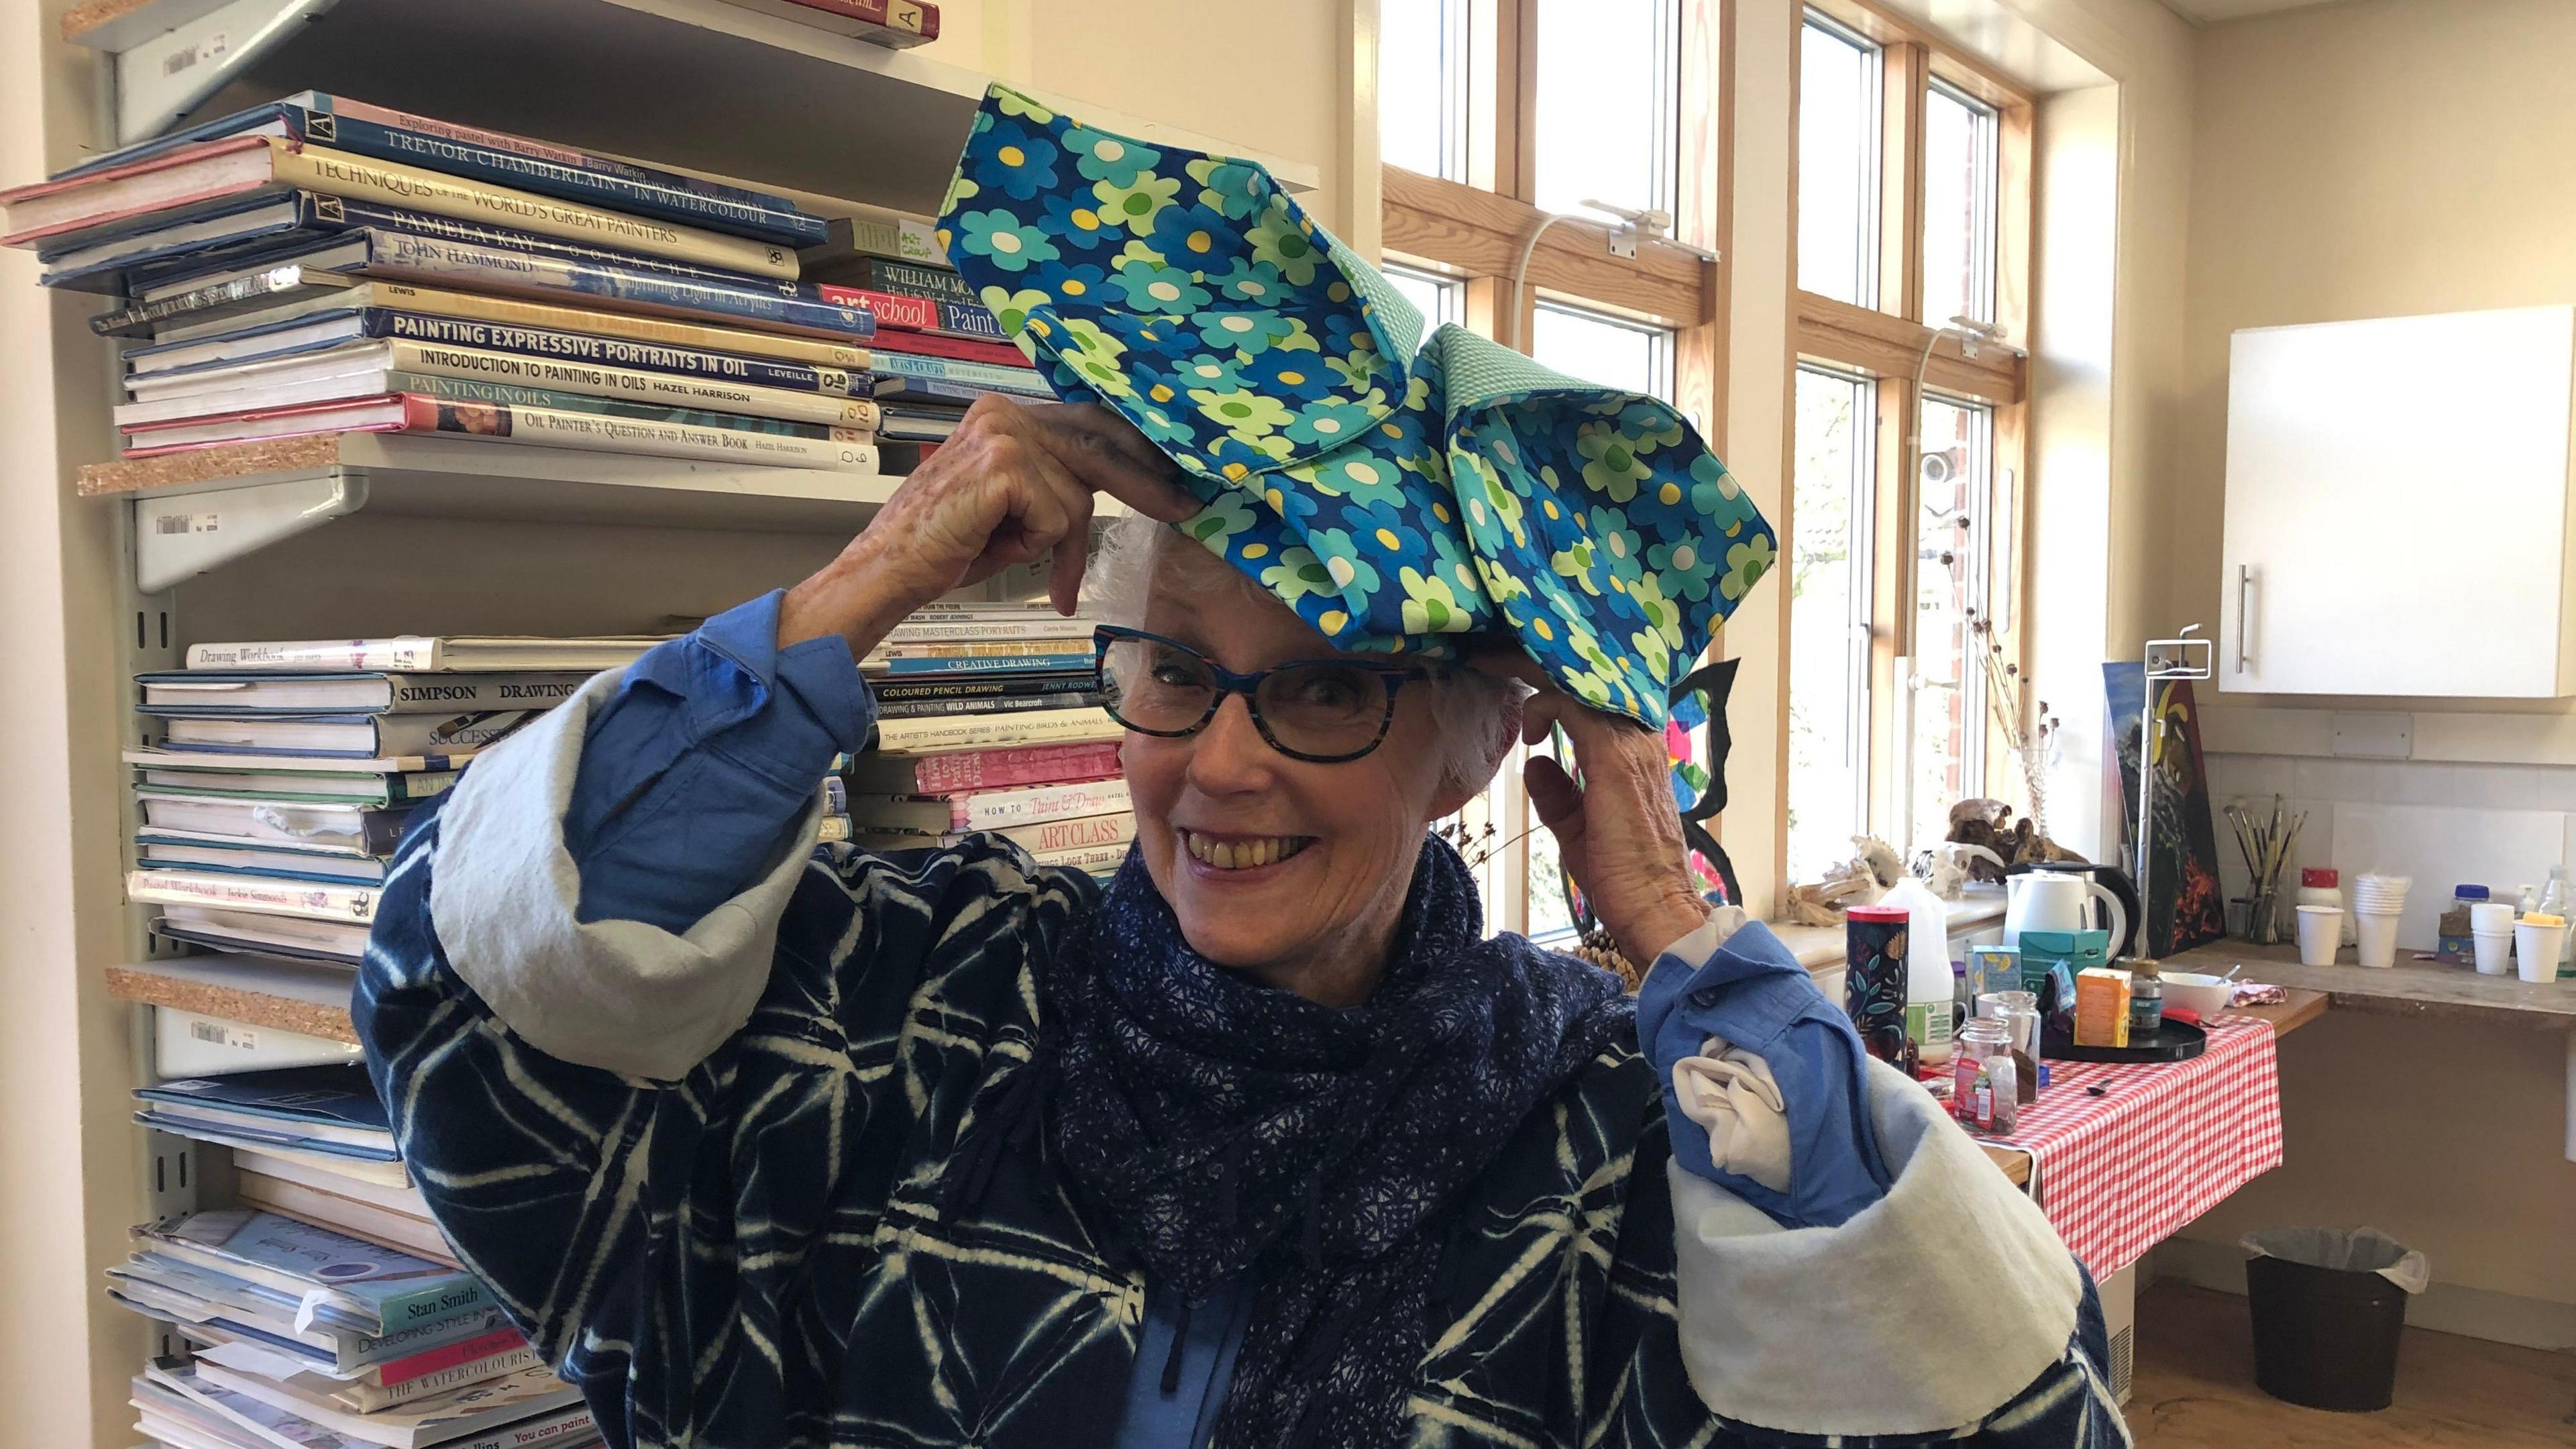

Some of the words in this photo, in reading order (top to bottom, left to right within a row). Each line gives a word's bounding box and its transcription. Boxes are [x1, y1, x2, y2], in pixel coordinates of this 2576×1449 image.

[898, 11, 917, 27] A
[311, 117, 333, 135] A
[399, 114, 451, 139] Exploring
[455, 129, 484, 146] pastel
[486, 136, 511, 150] with
[514, 142, 539, 158] Barry
[543, 148, 577, 164] Watkin
[385, 130, 470, 162] TREVOR
[477, 150, 616, 191] CHAMBERLAIN
[587, 158, 611, 174] Barry
[614, 164, 645, 179] Watkin
[315, 158, 433, 197] TECHNIQUES
[436, 186, 450, 196] OF
[452, 189, 470, 201] THE
[473, 191, 548, 220] WORLD'S
[552, 207, 602, 229] GREAT
[608, 218, 678, 244] PAINTERS
[320, 200, 341, 217] A
[634, 186, 650, 201] IN
[657, 191, 767, 225] WATERCOLOUR
[392, 210, 488, 244] PAMELA
[495, 229, 535, 252] KAY
[569, 244, 699, 278] GOUACHE
[396, 237, 441, 260] JOHN
[447, 244, 534, 274] HAMMOND
[388, 286, 416, 297] LEWIS
[884, 266, 947, 291] WILLIAM
[950, 278, 976, 296] MO
[683, 284, 710, 305] Light
[714, 289, 726, 303] in
[729, 292, 773, 313] Acrylics
[832, 294, 871, 309] art
[874, 296, 927, 325] school
[947, 305, 996, 334] Paint
[393, 316, 486, 344] PAINTING
[491, 327, 600, 358] EXPRESSIVE
[606, 341, 698, 370] PORTRAITS
[702, 355, 718, 373] IN
[722, 358, 749, 377] OIL
[421, 349, 521, 376] INTRODUCTION
[524, 362, 541, 378] TO
[545, 365, 602, 386] PAINTING
[605, 371, 617, 388] IN
[621, 374, 646, 392] OILS
[653, 382, 690, 397] HAZEL
[692, 386, 751, 404] HARRISON
[768, 368, 814, 382] LEVEILLE
[892, 359, 910, 371] ARTS
[911, 362, 918, 372] &
[918, 363, 945, 376] CRAFTS
[410, 376, 494, 401] PAINTING
[496, 386, 513, 402] IN
[515, 389, 551, 407] OILS
[525, 412, 545, 428] OIL
[548, 415, 602, 435] PAINTER'S
[604, 420, 655, 441] QUESTION
[658, 428, 678, 441] AND
[681, 430, 719, 447] ANSWER
[721, 433, 748, 451] BOOK
[755, 440, 775, 451] HAZEL
[777, 442, 808, 455] HARRISON
[885, 627, 921, 638] RAWING
[922, 625, 979, 637] MASTERCLASS
[981, 625, 1027, 636] PORTRAITS
[200, 648, 236, 666] Drawing
[948, 659, 1004, 670] CREATIVE
[1004, 658, 1051, 669] DRAWING
[400, 686, 477, 702] SIMPSON
[499, 683, 575, 699] DRAWING
[882, 688, 930, 698] COLOURED
[932, 686, 963, 696] PENCIL
[964, 684, 1004, 694] DRAWING
[1041, 682, 1067, 692] JENNY
[879, 702, 909, 716] DRAWING
[910, 704, 916, 713] &
[917, 702, 945, 713] PAINTING
[946, 701, 964, 712] WILD
[965, 700, 996, 711] ANIMALS
[1004, 699, 1014, 709] Vic
[1015, 698, 1043, 708] Bearcroft
[885, 733, 898, 741] THE
[900, 731, 929, 740] ARTIST'S
[930, 729, 967, 738] HANDBOOK
[969, 727, 991, 735] SERIES
[995, 722, 1035, 733] PAINTING
[1036, 720, 1059, 731] BIRDS
[1060, 719, 1068, 729] &
[1070, 717, 1104, 727] ANIMALS
[417, 778, 434, 793] AN
[984, 806, 1005, 816] HOW
[1010, 804, 1022, 812] TO
[1030, 796, 1059, 816] Paint
[1073, 791, 1106, 809] Draw
[1038, 825, 1069, 851] ART
[1070, 818, 1120, 847] CLASS
[1061, 855, 1083, 867] LOOK
[1083, 851, 1109, 865] THREE
[407, 1302, 437, 1320] Stan
[440, 1286, 479, 1311] Smith
[358, 1322, 434, 1354] DEVELOPING
[437, 1314, 470, 1332] STYLE
[387, 1381, 413, 1399] THE
[514, 1432, 536, 1444] You
[538, 1426, 559, 1438] can
[561, 1414, 590, 1433] paint
